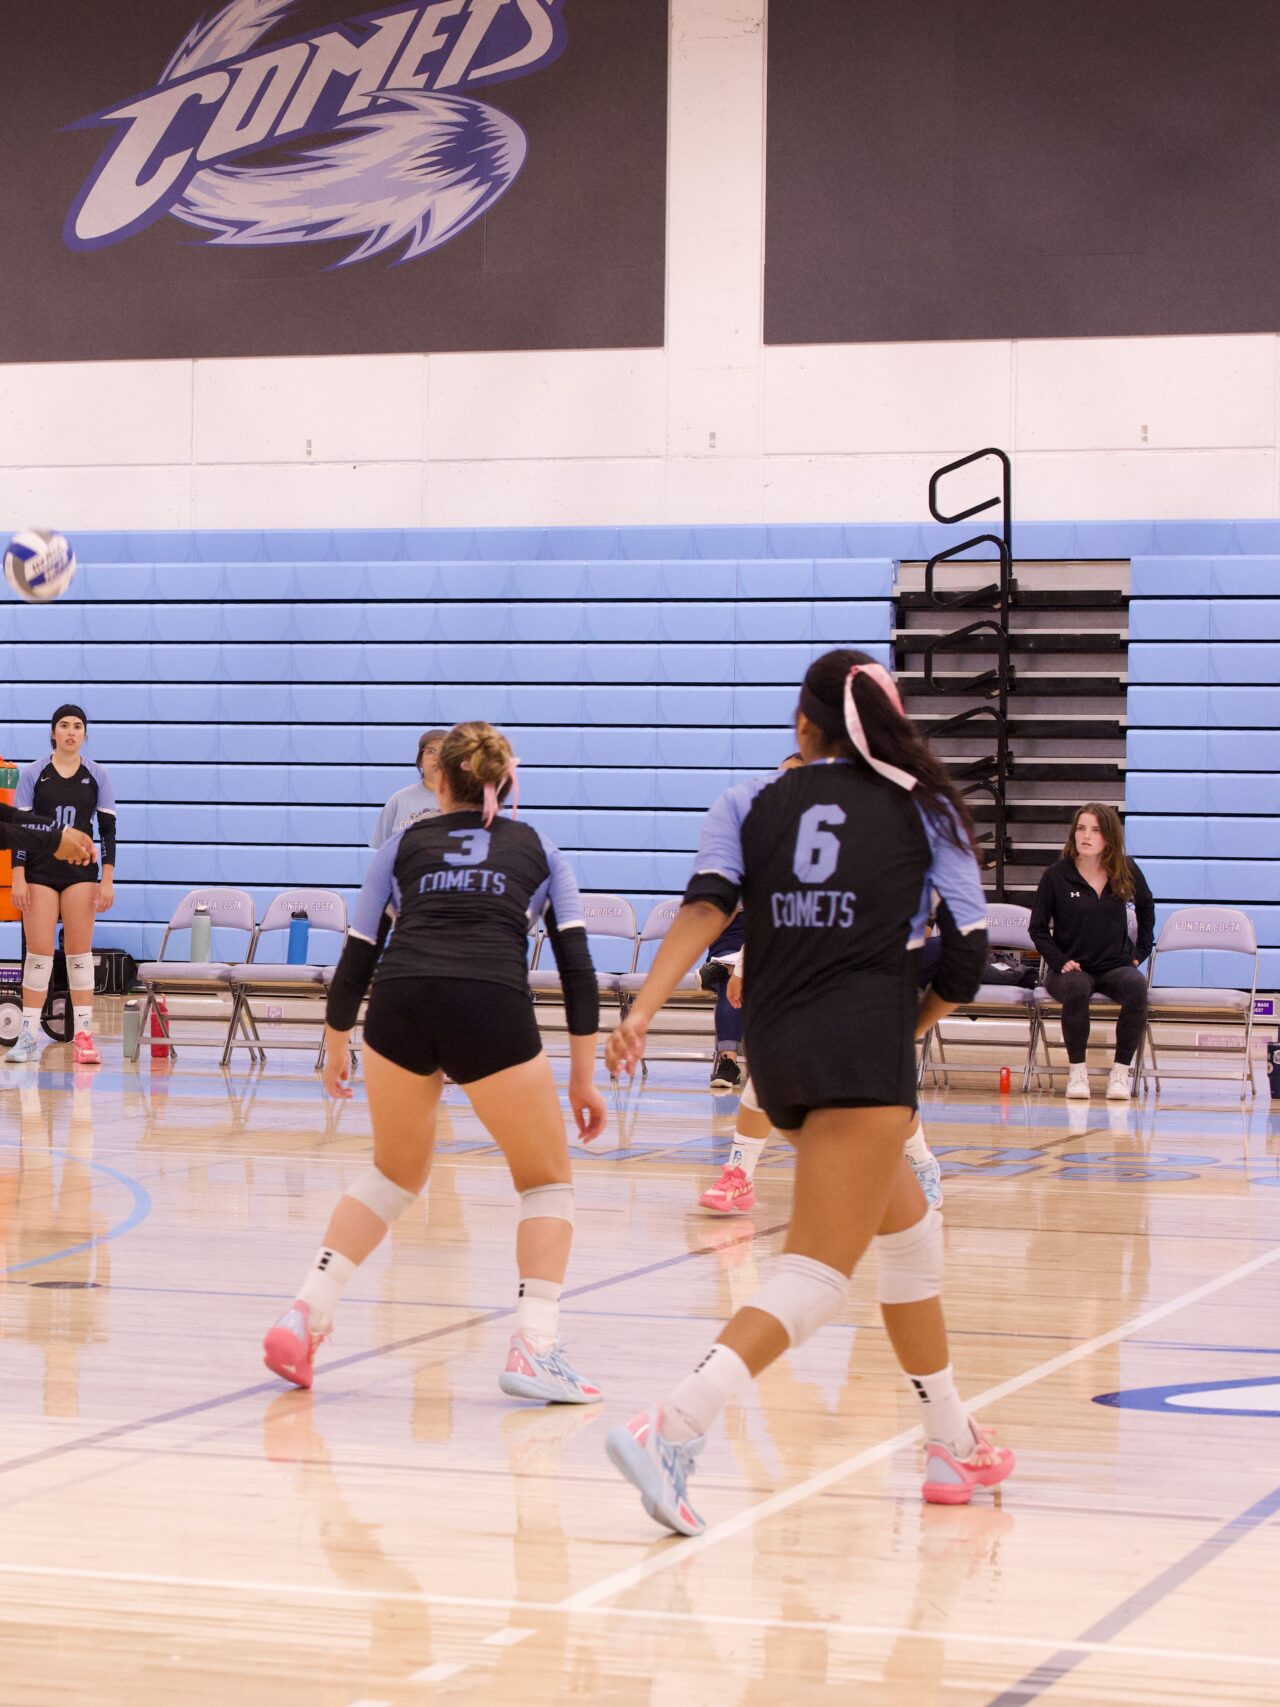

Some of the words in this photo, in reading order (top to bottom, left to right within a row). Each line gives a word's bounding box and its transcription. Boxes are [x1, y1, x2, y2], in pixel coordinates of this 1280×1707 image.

[76, 0, 554, 239] COMETS
[55, 805, 76, 829] 10
[443, 828, 491, 867] 3
[793, 804, 846, 884] 6
[419, 869, 506, 896] COMETS
[771, 891, 856, 929] COMETS
[1175, 921, 1210, 933] CONTRA
[1213, 921, 1240, 933] COSTA
